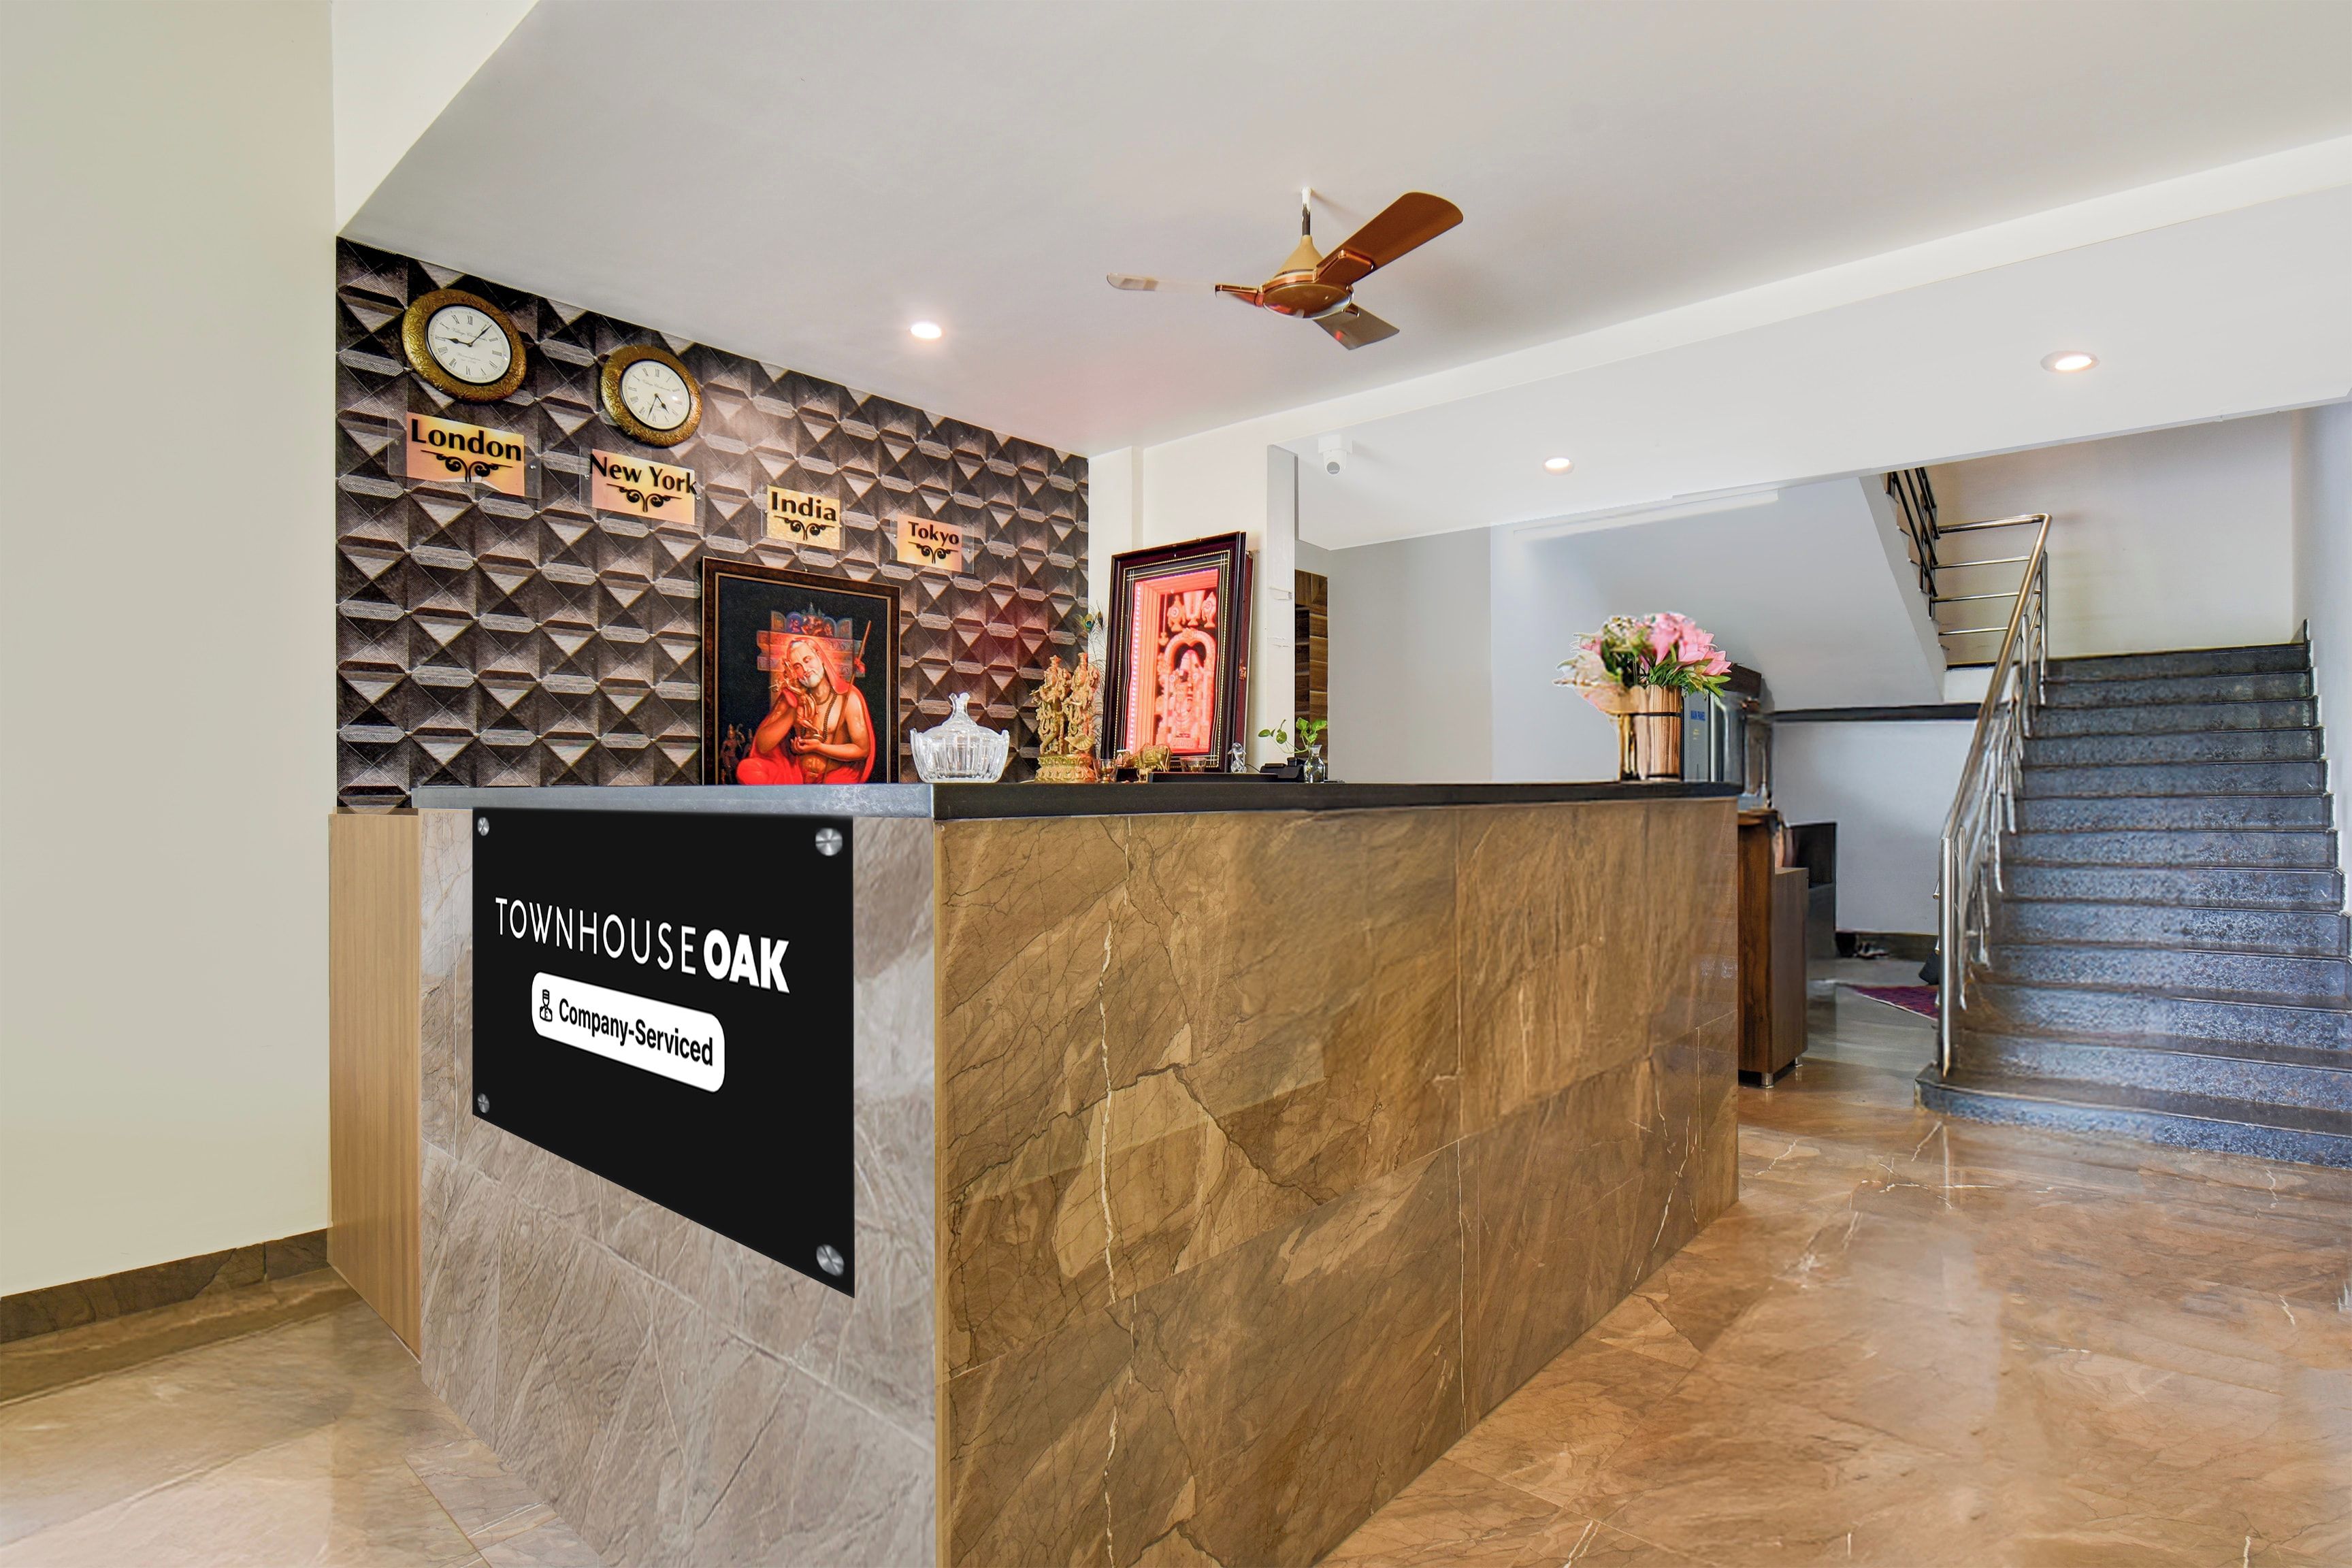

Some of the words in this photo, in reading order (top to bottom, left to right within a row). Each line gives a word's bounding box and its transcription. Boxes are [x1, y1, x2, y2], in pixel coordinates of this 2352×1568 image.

[411, 418, 521, 461] London
[589, 453, 642, 483] New
[649, 466, 698, 495] York
[771, 491, 837, 521] India
[907, 521, 960, 547] Tokyo
[495, 897, 697, 975] TOWNHOUSE
[703, 928, 791, 994] OAK
[558, 998, 714, 1067] Company-Serviced
